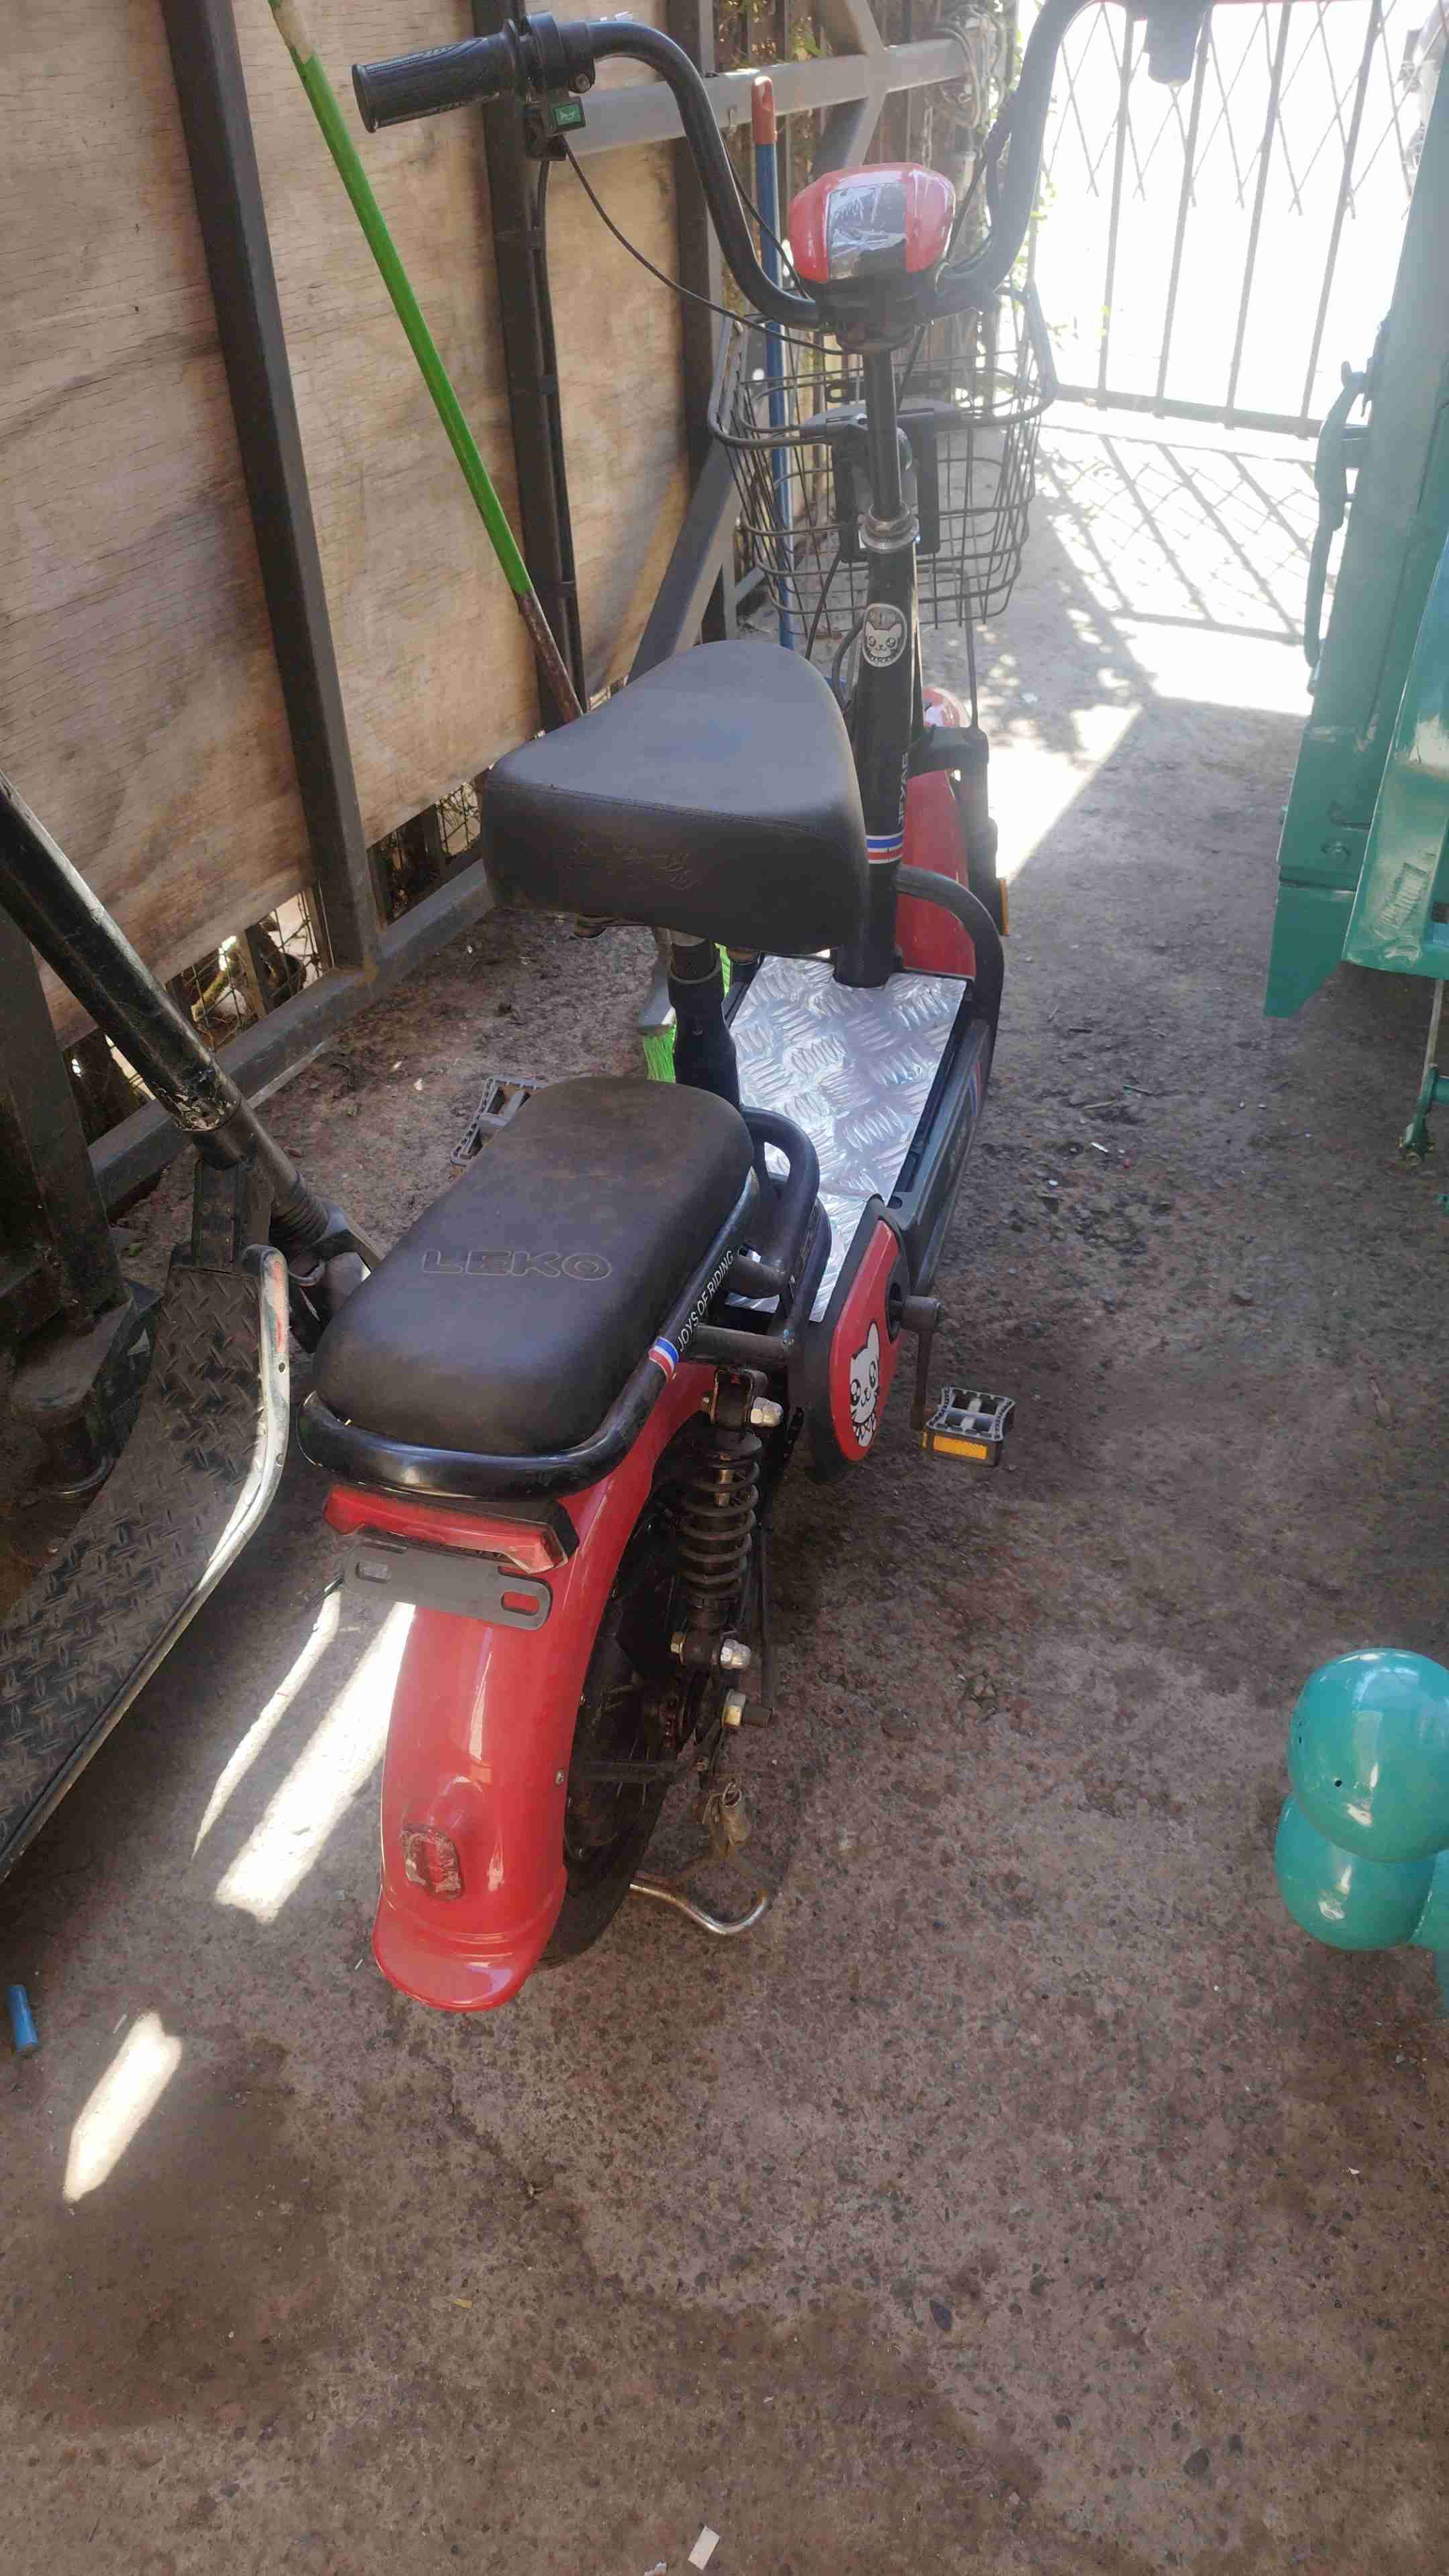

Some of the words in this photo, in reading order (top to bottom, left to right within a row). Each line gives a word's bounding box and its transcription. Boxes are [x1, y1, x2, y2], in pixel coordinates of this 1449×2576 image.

[421, 1249, 612, 1281] LEKO
[678, 1311, 698, 1352] JOYS
[697, 1291, 708, 1316] OF
[707, 1250, 733, 1299] RIDING
